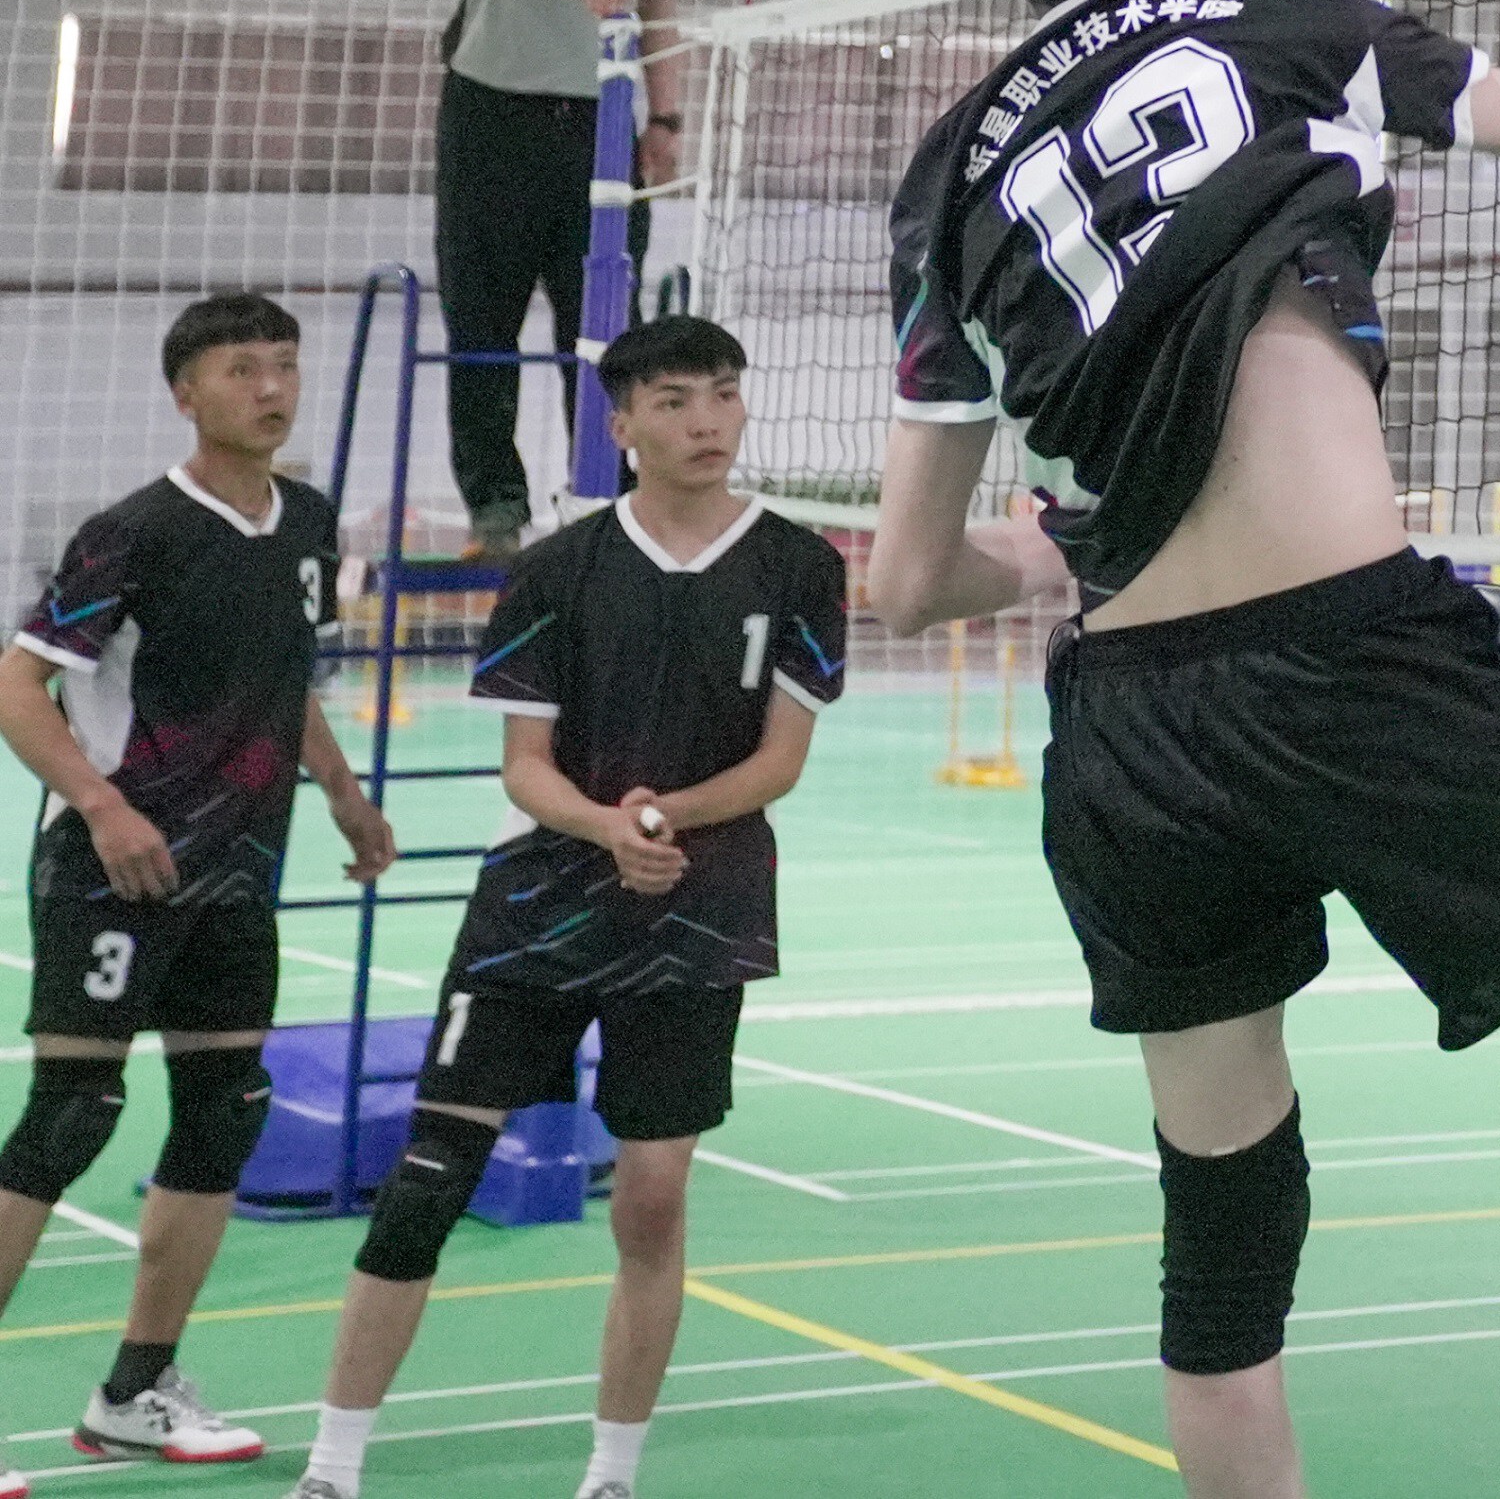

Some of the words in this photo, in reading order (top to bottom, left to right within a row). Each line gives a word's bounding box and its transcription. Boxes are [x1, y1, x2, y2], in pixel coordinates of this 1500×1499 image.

[1000, 37, 1256, 336] 12
[298, 557, 322, 625] 3
[741, 613, 770, 689] 1
[83, 930, 134, 1001] 3
[436, 991, 475, 1067] 1
